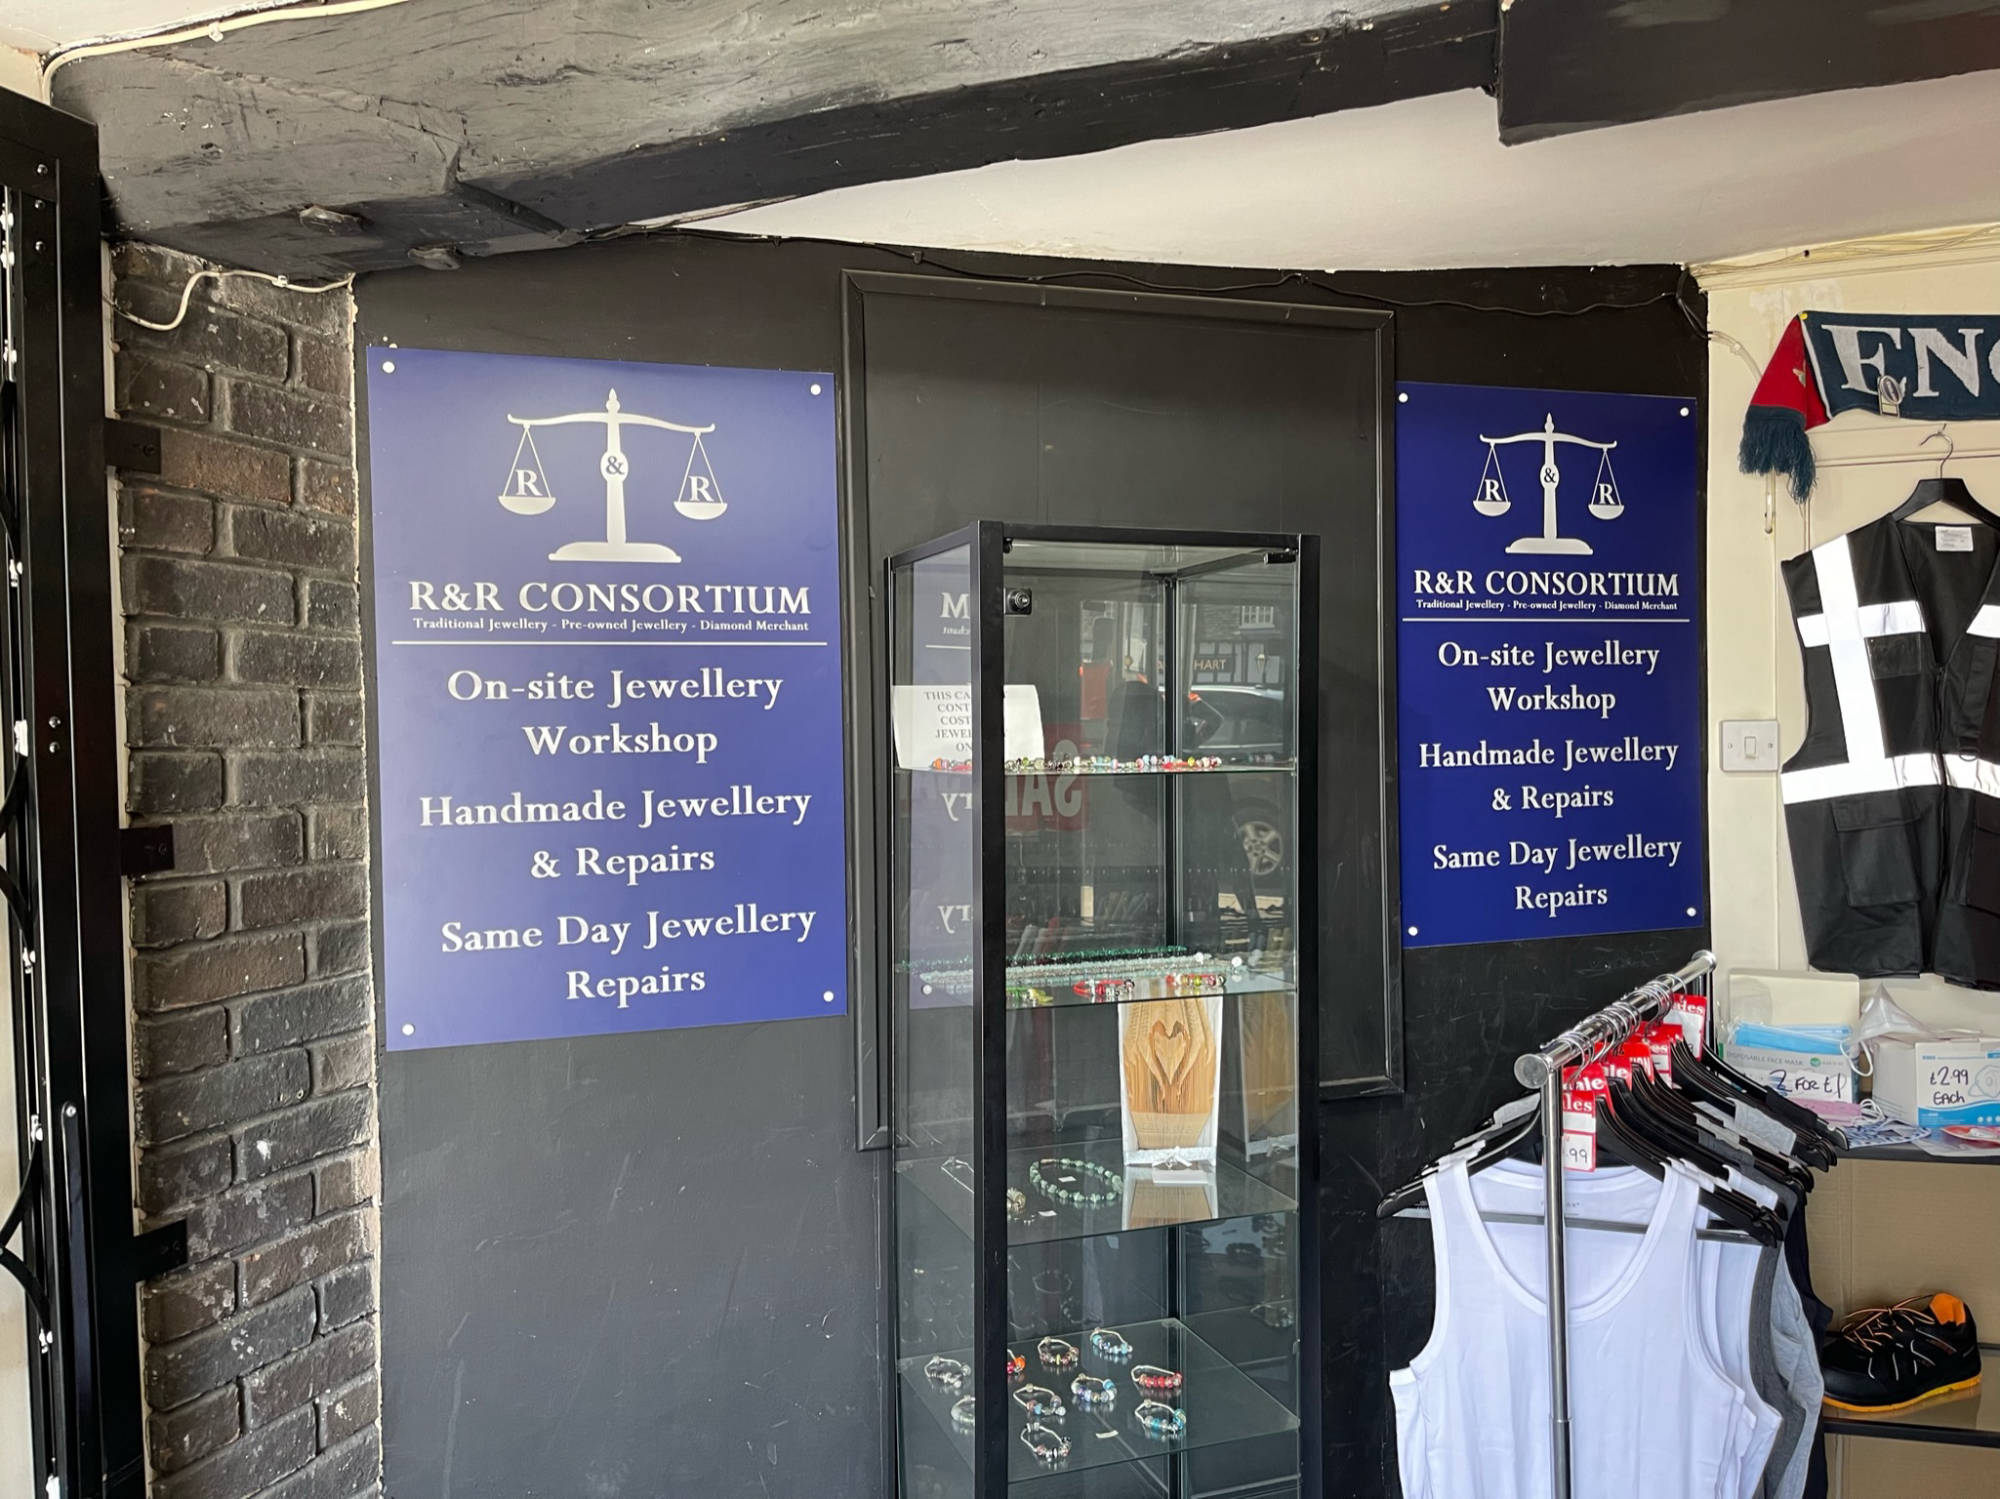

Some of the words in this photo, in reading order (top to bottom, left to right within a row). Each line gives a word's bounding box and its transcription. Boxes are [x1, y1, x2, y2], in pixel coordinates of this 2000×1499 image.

[1821, 324, 2000, 398] EN
[515, 469, 542, 496] R
[605, 456, 624, 476] &
[689, 475, 714, 502] R
[1484, 479, 1502, 500] R
[1544, 468, 1556, 484] &
[1600, 484, 1616, 504] R
[409, 581, 503, 612] R&R
[519, 582, 811, 614] CONSORTIUM
[1414, 570, 1475, 594] R&R
[1486, 570, 1679, 596] CONSORTIUM
[1416, 600, 1463, 609] Traditional
[1466, 600, 1504, 610] Jewellery
[1513, 600, 1556, 610] Pre-owned
[1559, 600, 1597, 612] Jewellery
[1604, 602, 1640, 610] Diamond
[1642, 602, 1677, 610] Merchant
[414, 618, 484, 630] Traditional
[488, 618, 548, 632] Jewellery
[562, 619, 627, 631] Pre-owned
[631, 619, 687, 633] Jewellery
[701, 620, 752, 631] Diamond
[756, 620, 808, 631] Merchant
[1438, 641, 1534, 667] On-site
[1543, 640, 1660, 675] Jewellery
[447, 671, 595, 702] On-site
[607, 668, 784, 710] Jewellery
[923, 691, 952, 701] THIS
[1486, 684, 1616, 719] Workshop
[521, 722, 719, 764] Workshop
[1419, 739, 1555, 768] Handmade
[1562, 737, 1679, 771] Jewellery
[419, 790, 627, 827] Handmade
[638, 785, 812, 828] Jewellery
[1492, 788, 1511, 811] &
[1521, 784, 1614, 818] Repairs
[531, 851, 560, 879] &
[576, 845, 715, 887] Repairs
[1433, 844, 1500, 870] Same
[1509, 841, 1558, 874] Day
[1566, 834, 1682, 870] Jewellery
[1515, 883, 1608, 917] Repairs
[441, 921, 544, 953] Same
[557, 916, 631, 955] Day
[643, 904, 816, 950] Jewellery
[566, 967, 706, 1008] Repairs
[1795, 1077, 1820, 1091] FOR
